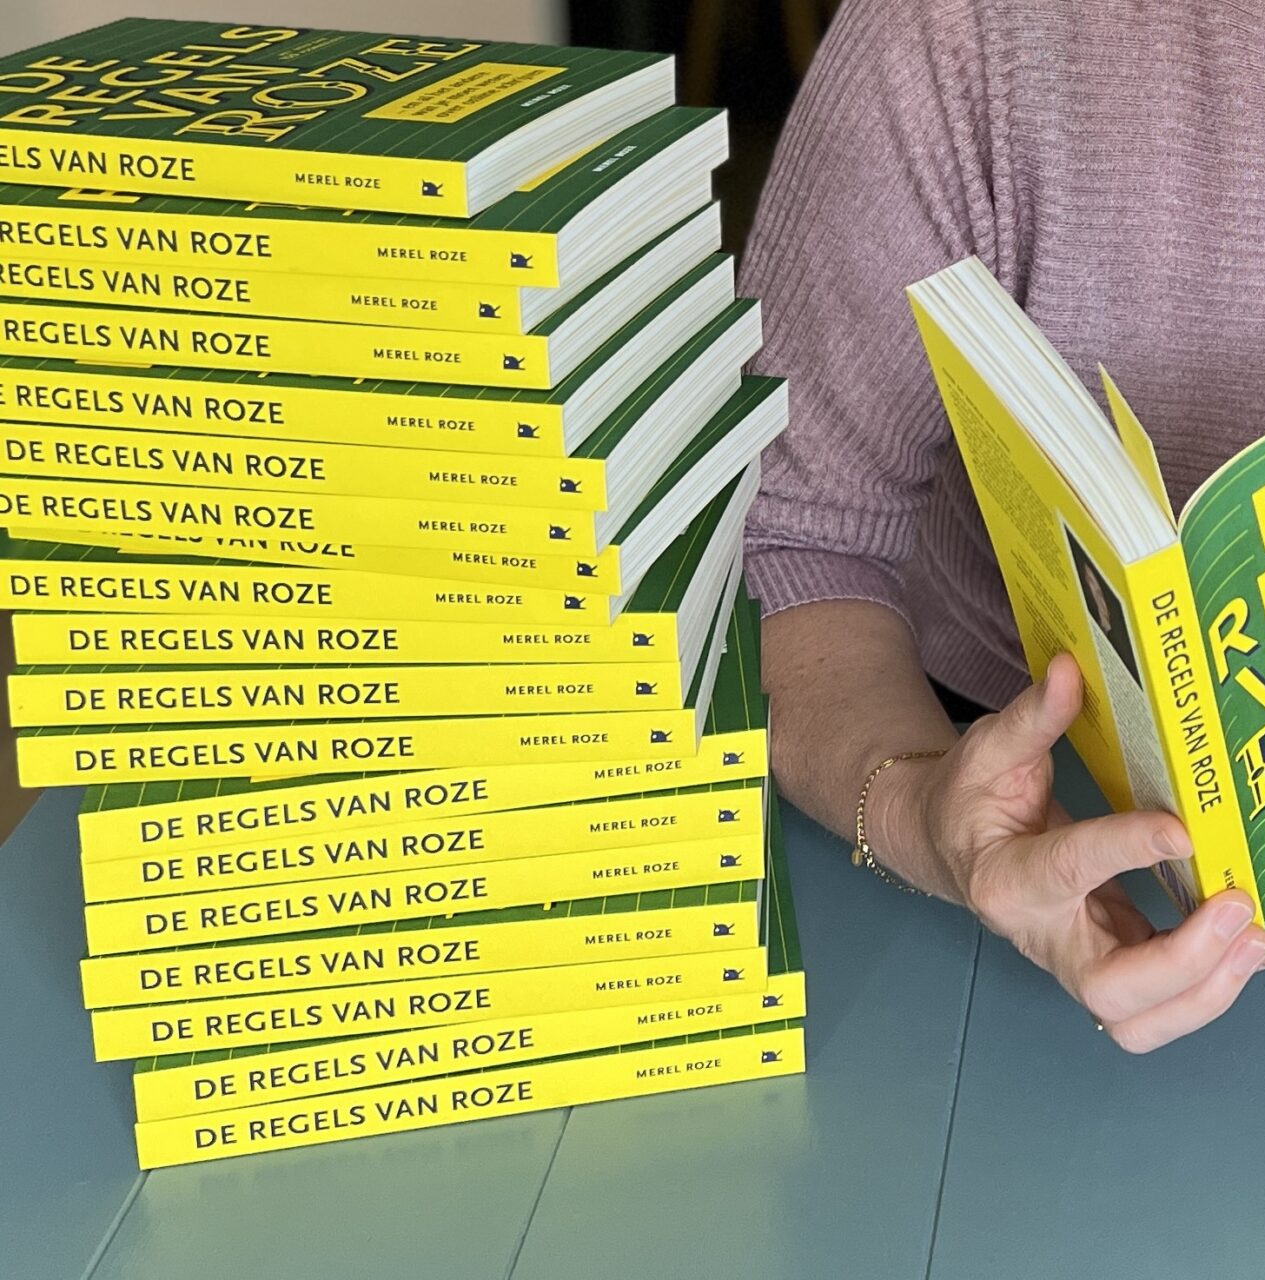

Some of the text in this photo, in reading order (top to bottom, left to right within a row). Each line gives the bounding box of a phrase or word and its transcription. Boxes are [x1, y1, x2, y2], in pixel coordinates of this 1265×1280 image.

[0, 56, 120, 95] DE
[1, 26, 299, 126] REGELS
[98, 65, 299, 120] VAN
[173, 39, 483, 142] ROZE
[49, 148, 381, 190] VAN ROZE MEREL ROZE
[0, 220, 467, 262] REGELS VAN ROZE MEREL ROZE
[5, 439, 517, 487] DE REGELS VAN ROZE MEREL ROZE
[452, 551, 537, 569] MEREL ROZE
[10, 574, 523, 605] DE REGELS VAN ROZE MEREL ROZE
[69, 628, 591, 651] DE REGELS VAN ROZE MEREL ROZE
[75, 733, 608, 772] DE REGELS VAN ROZE MEREL ROZE
[1152, 590, 1236, 889] DE REGELS VAN ROZE MER
[142, 815, 676, 883] DE REGELS VAN ROZE MEREL ROZE
[140, 928, 672, 990] DE REGELS VAN ROZE MEREL ROZE
[195, 1059, 720, 1149] DE REGELS VAN ROZE MEREL ROZE
